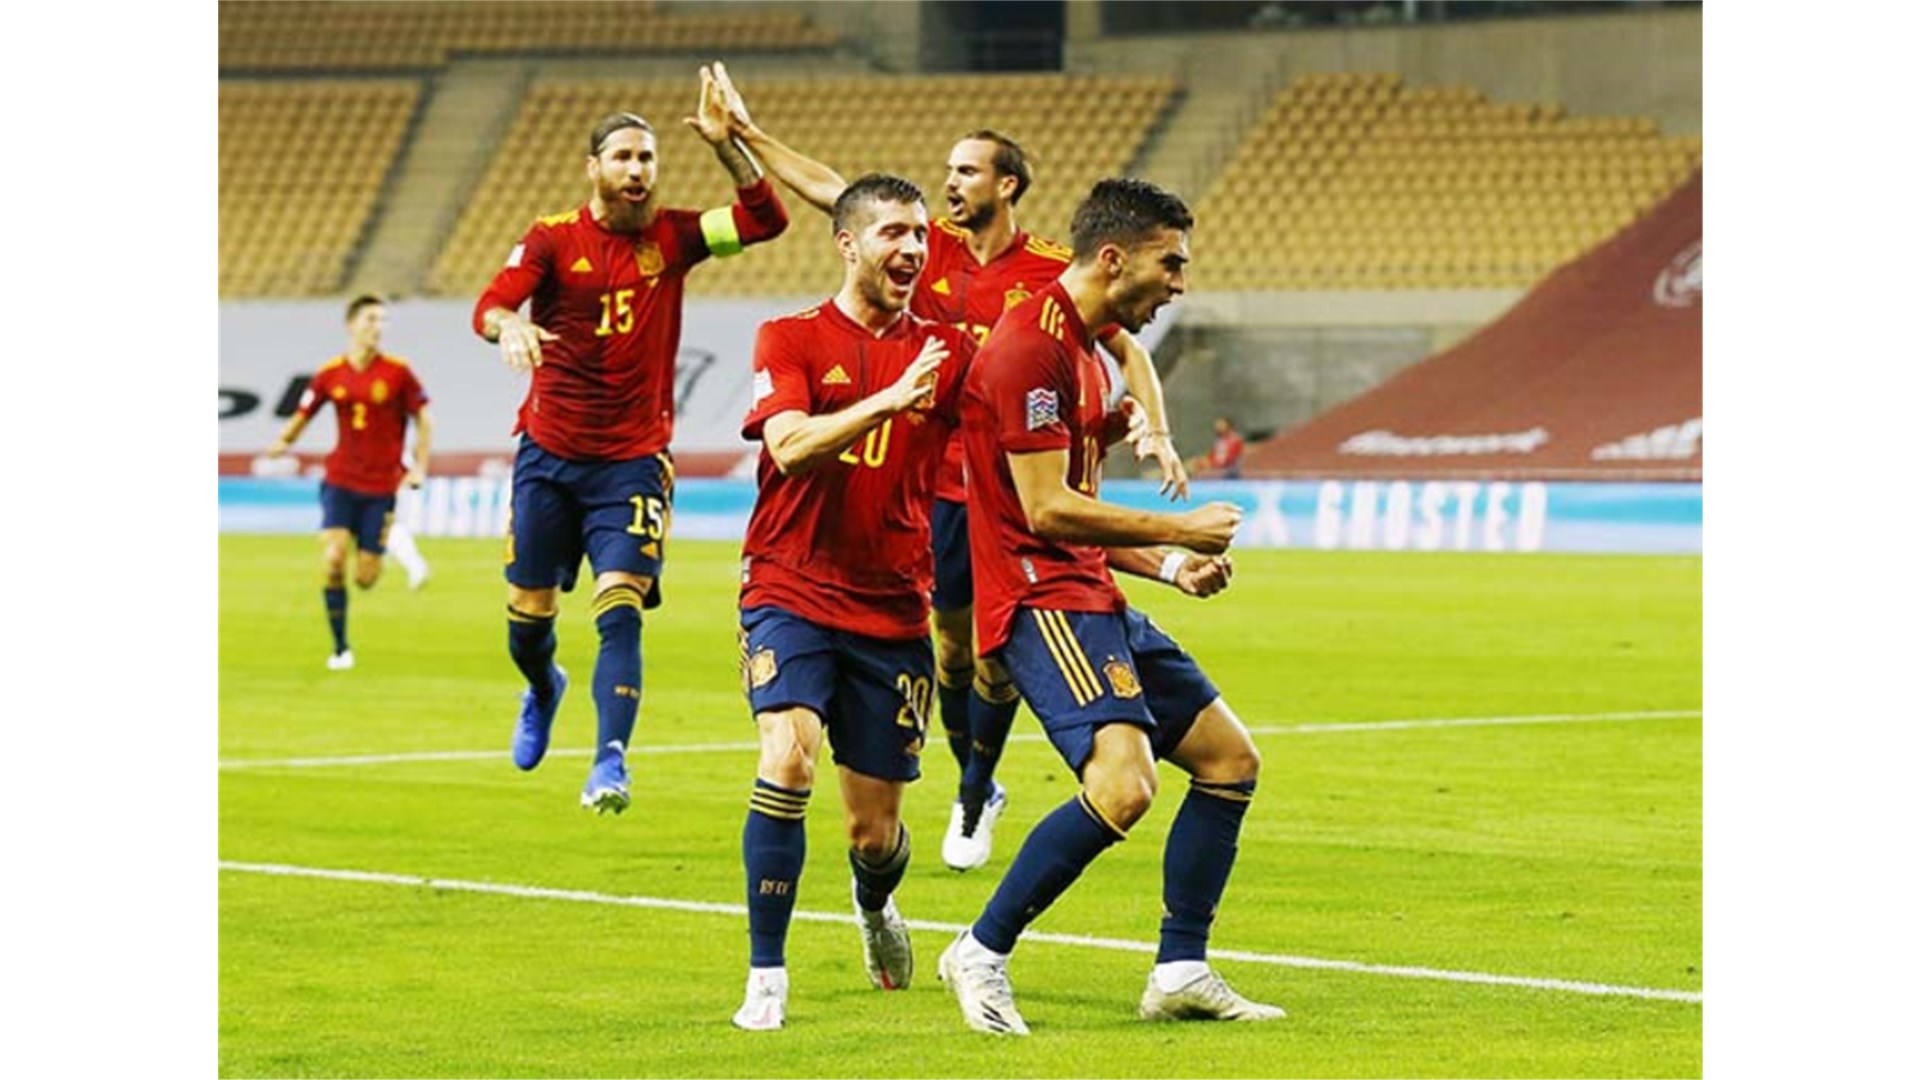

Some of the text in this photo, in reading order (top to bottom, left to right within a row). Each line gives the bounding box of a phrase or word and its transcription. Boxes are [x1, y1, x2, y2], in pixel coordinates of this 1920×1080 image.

[595, 289, 635, 336] 15
[627, 495, 663, 540] 15
[896, 673, 929, 731] 20
